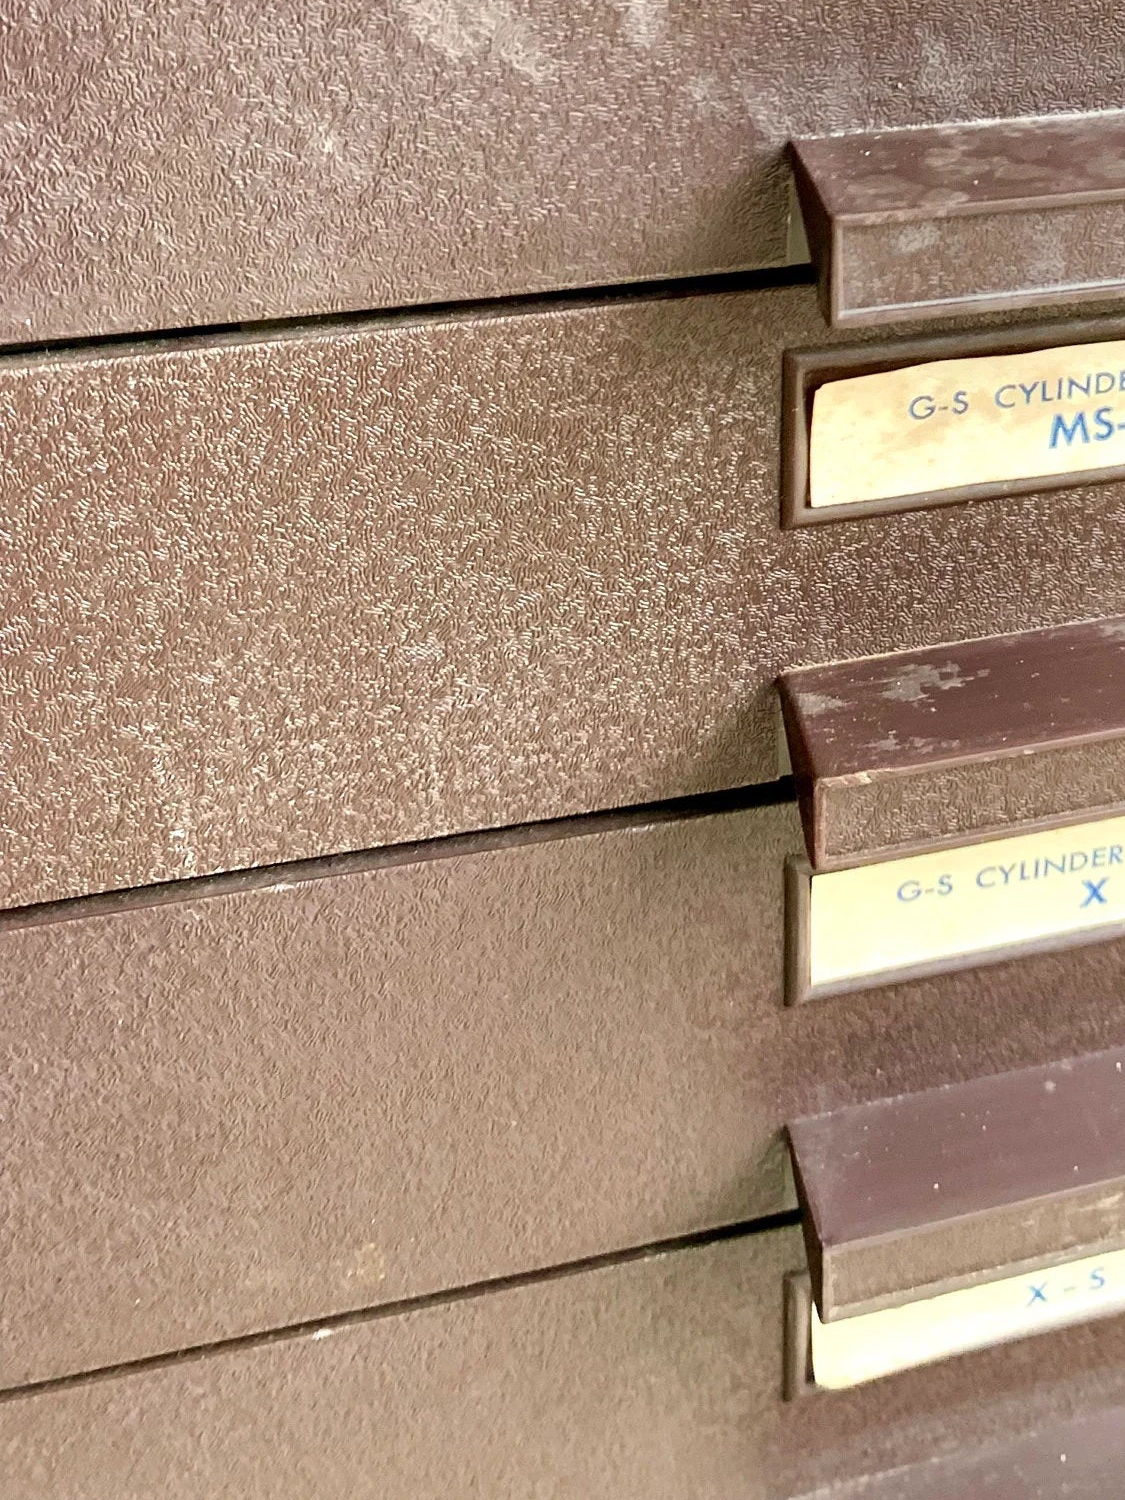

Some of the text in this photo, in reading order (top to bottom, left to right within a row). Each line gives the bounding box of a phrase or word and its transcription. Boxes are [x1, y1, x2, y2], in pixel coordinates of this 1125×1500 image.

[908, 390, 969, 421] G-S
[896, 874, 954, 904] G-S
[975, 844, 1125, 890] CYLINDER
[1079, 875, 1111, 909] X
